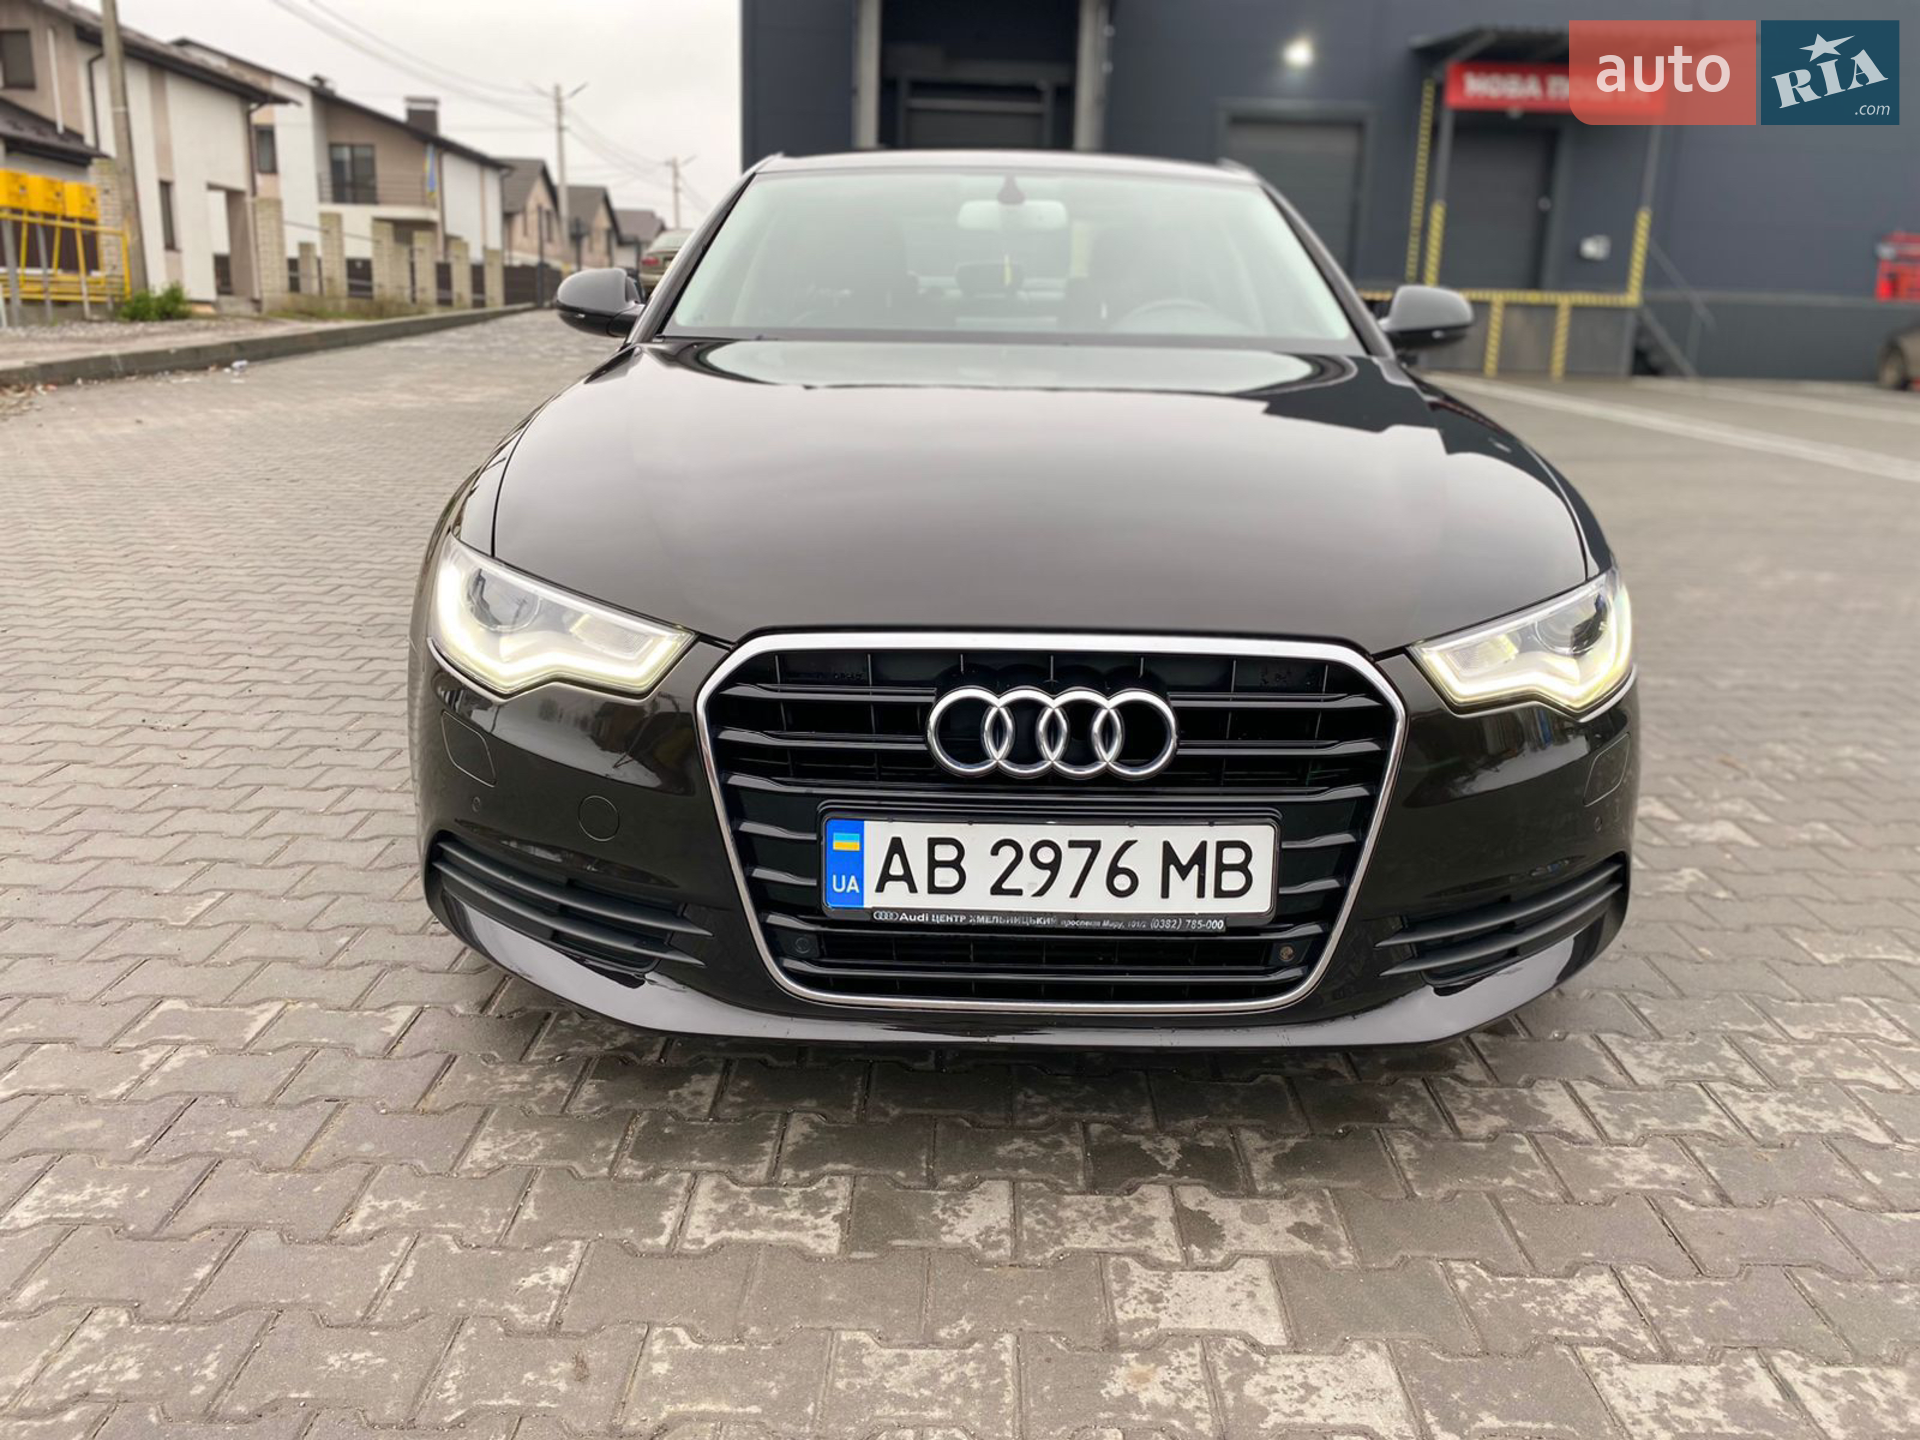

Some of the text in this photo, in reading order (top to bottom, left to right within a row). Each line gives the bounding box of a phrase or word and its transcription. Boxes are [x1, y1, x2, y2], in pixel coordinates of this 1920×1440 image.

[874, 836, 1253, 899] AB 2976 MB
[832, 874, 860, 894] UA
[899, 912, 929, 922] Audi
[932, 914, 967, 924] ЦЕНТР
[1150, 919, 1182, 930] (0382)
[1185, 919, 1224, 930] 785-000
